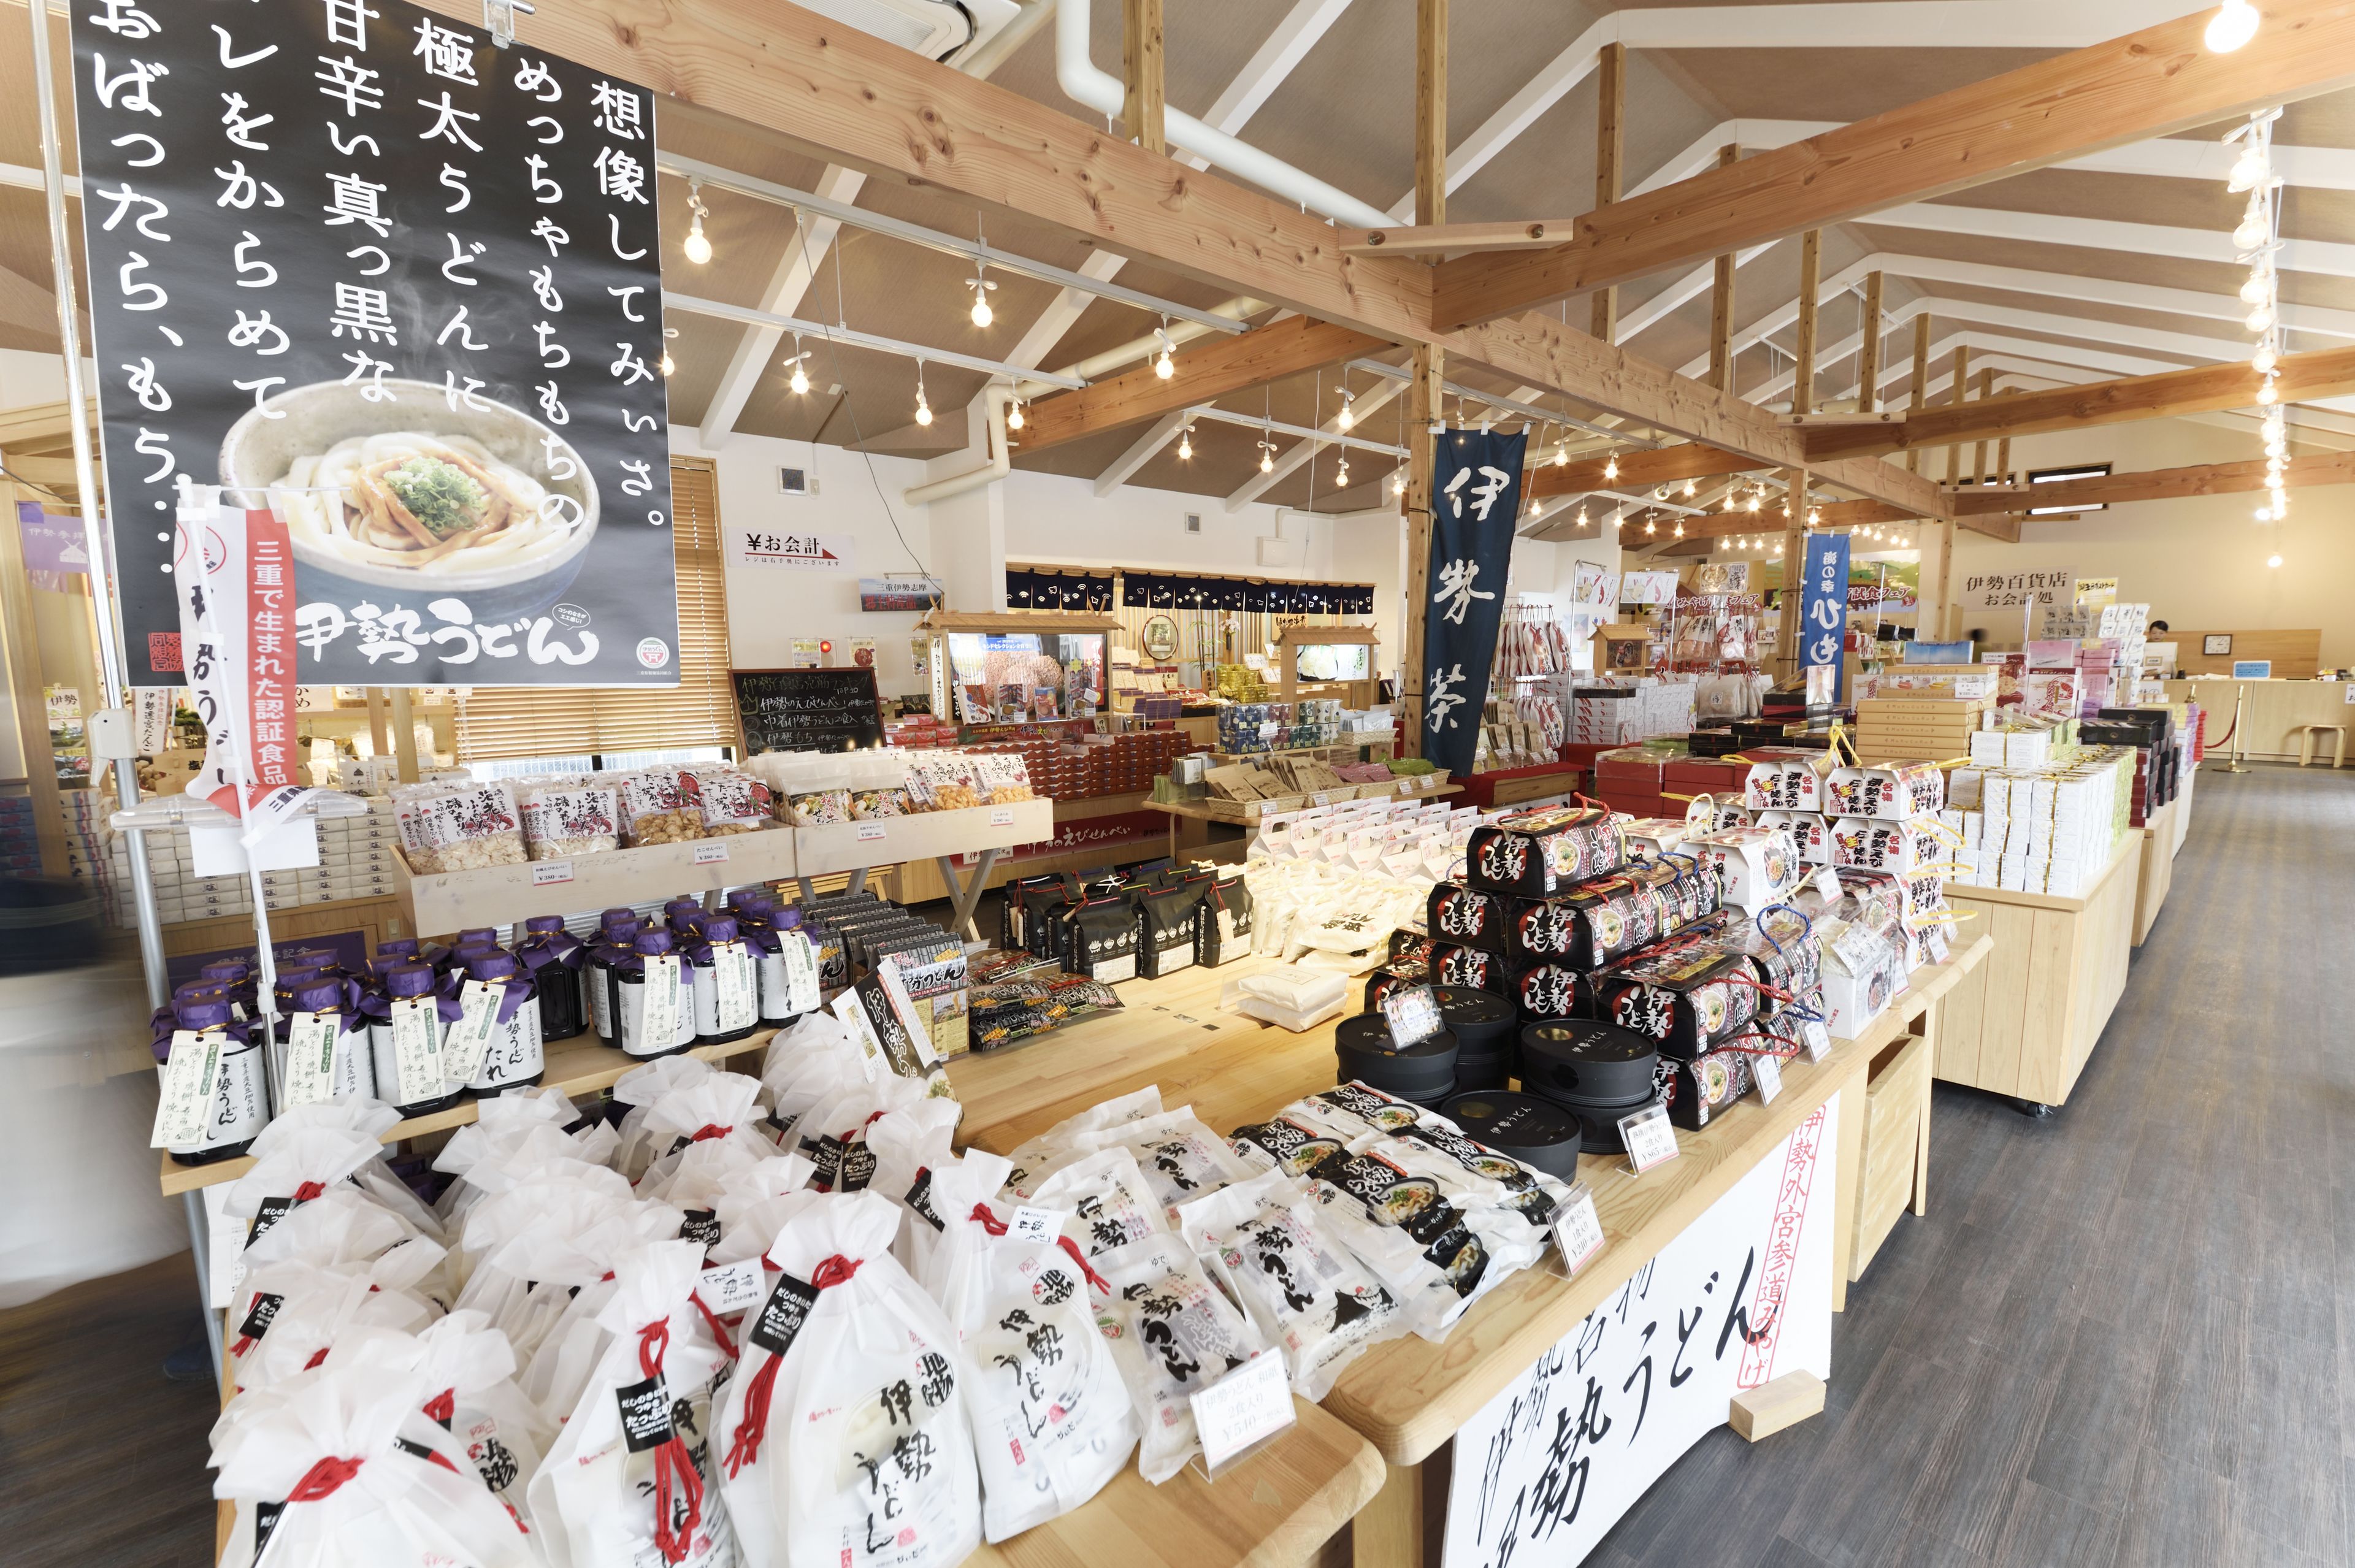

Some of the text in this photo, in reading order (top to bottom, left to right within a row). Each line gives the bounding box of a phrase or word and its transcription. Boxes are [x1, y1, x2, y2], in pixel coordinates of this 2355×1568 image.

[315, 0, 397, 402] 甘辛い真っ黒な
[413, 18, 491, 412] 極太うどんに
[514, 58, 584, 530] めっちゃもちもちの
[745, 557, 840, 567] レジは右手奥にございます
[1822, 551, 1837, 593] 海の幸
[876, 583, 927, 592] 三重伊勢志摩
[1966, 572, 2069, 593] 伊勢百貨店
[1985, 591, 2054, 607] お会計処
[558, 607, 587, 618] コシのなさが
[1424, 466, 1510, 734] 伊勢茶
[296, 597, 600, 664] 伊勢うどん
[253, 541, 288, 784] 三重で生まれた認証食品
[50, 694, 77, 705] 伊勢
[1785, 771, 1802, 808] 伊勢えび
[1802, 776, 1813, 795] 名物
[1864, 777, 1883, 816] 伊勢えび
[1882, 782, 1893, 802] 名物
[1810, 827, 1821, 845] 名物
[1871, 830, 1890, 867] 伊勢えび
[1889, 836, 1901, 855] 名物
[1504, 834, 1530, 880] 伊勢
[1462, 890, 1489, 936] 伊勢
[1548, 904, 1577, 954] 伊勢
[1464, 949, 1489, 988] 伊勢
[1549, 966, 1577, 1015] 伊勢
[1642, 987, 1676, 1038] 伊勢
[1572, 1031, 1607, 1054] 伊勢うどん
[486, 1046, 507, 1081] たれ
[1490, 1106, 1532, 1136] 伊勢うどん
[813, 1153, 841, 1171] たっぷり
[844, 1160, 875, 1172] たっぷり
[1565, 1206, 1587, 1230] 伊勢うどん
[1744, 1109, 1825, 1387] 伊勢外宮参道みやげ
[765, 1304, 802, 1330] たっぷり
[1205, 1378, 1255, 1409] 伊勢うどん
[626, 1402, 673, 1428] たっぷり
